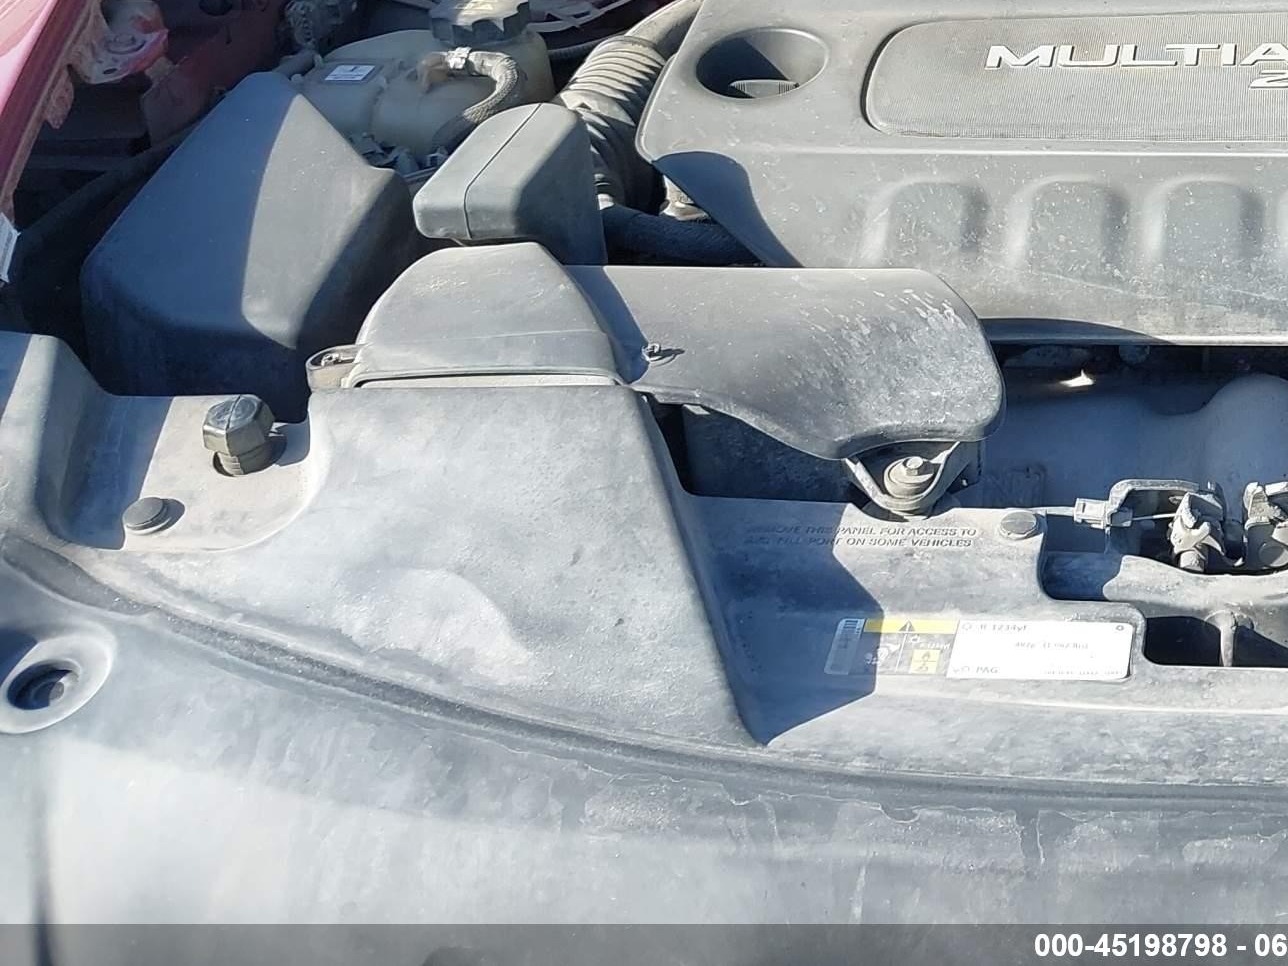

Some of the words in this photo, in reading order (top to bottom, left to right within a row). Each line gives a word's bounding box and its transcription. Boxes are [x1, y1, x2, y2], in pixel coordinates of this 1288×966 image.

[836, 526, 876, 535] PANEL
[880, 527, 905, 536] FOR
[908, 527, 957, 536] ACCESS
[959, 527, 977, 537] TO
[807, 537, 843, 546] PORT
[846, 537, 866, 546] ON
[868, 538, 908, 547] SOME
[911, 538, 972, 547] VEHICLES
